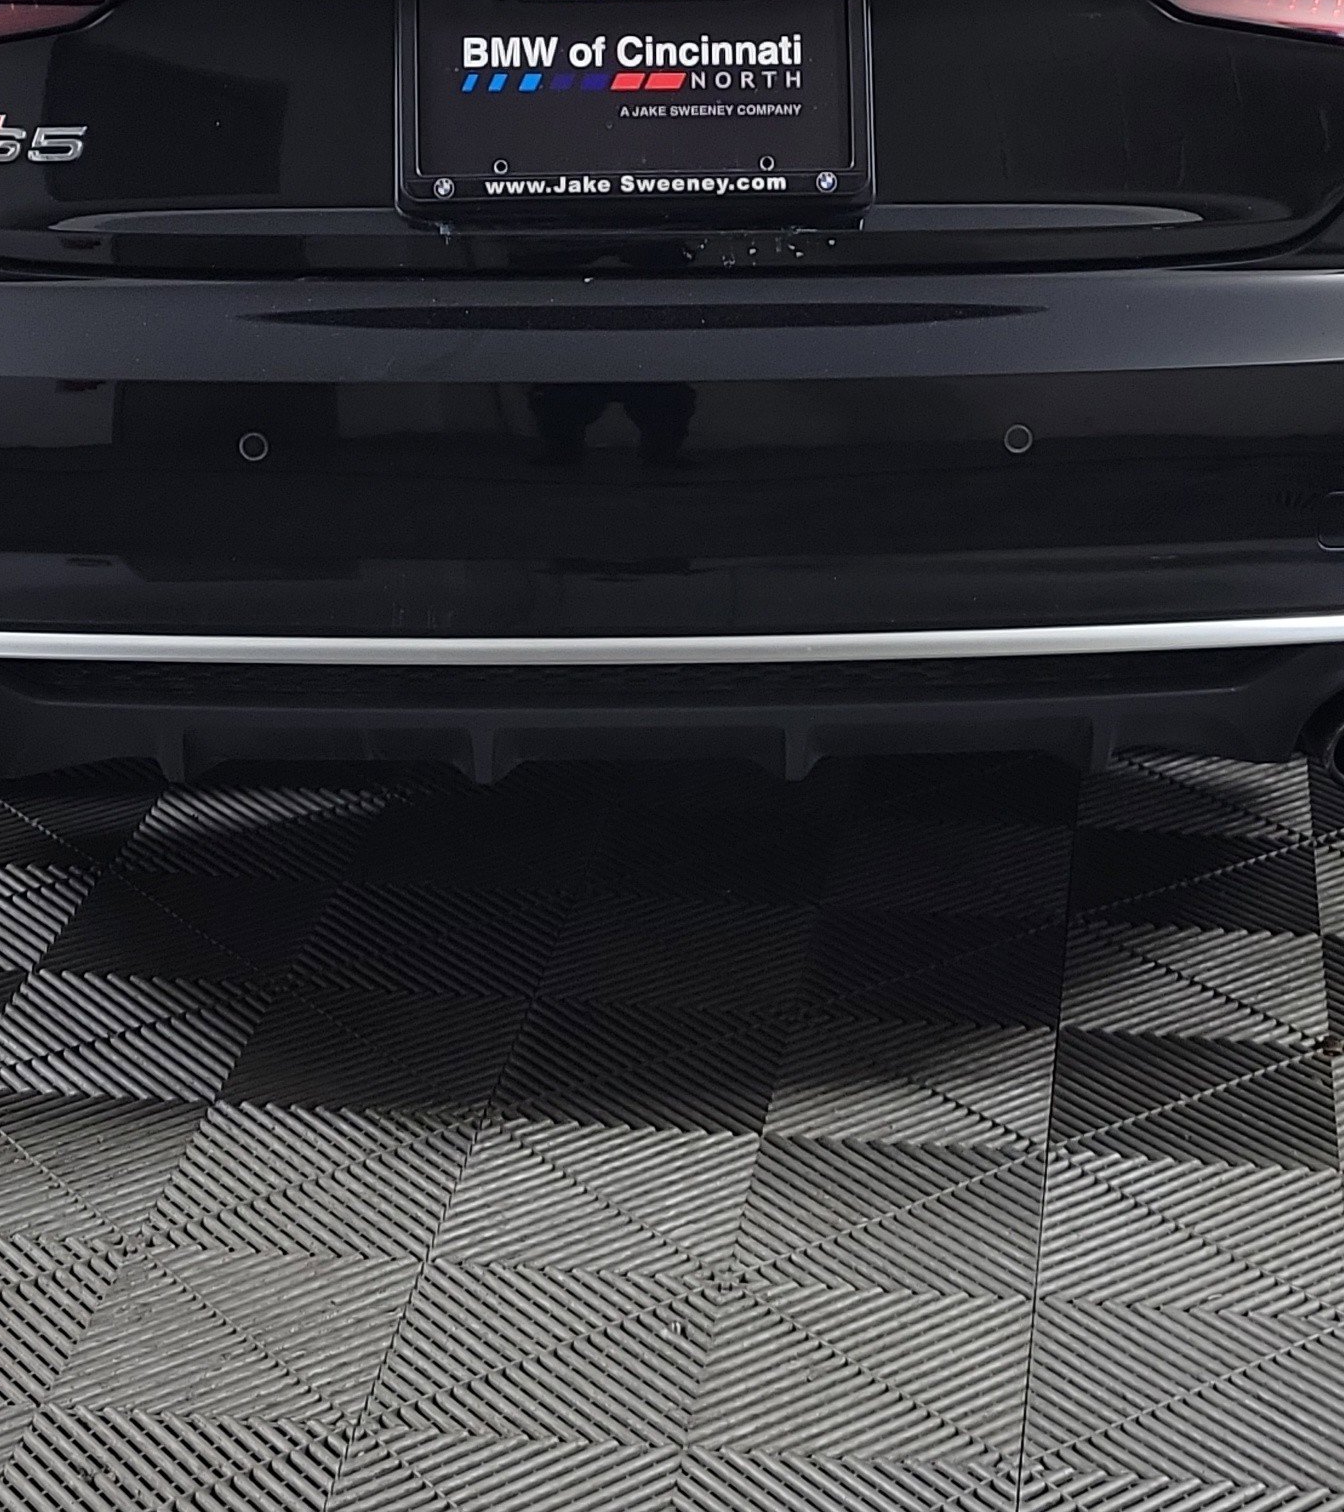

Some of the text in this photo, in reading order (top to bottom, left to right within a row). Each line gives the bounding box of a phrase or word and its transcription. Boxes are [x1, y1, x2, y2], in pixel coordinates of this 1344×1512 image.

[462, 34, 802, 68] BMW of Cincinnati
[691, 71, 802, 89] NORTH
[620, 104, 802, 117] A JAKE SWEENEY COMPANY
[485, 174, 787, 195] www.Jake Sweeney.com
